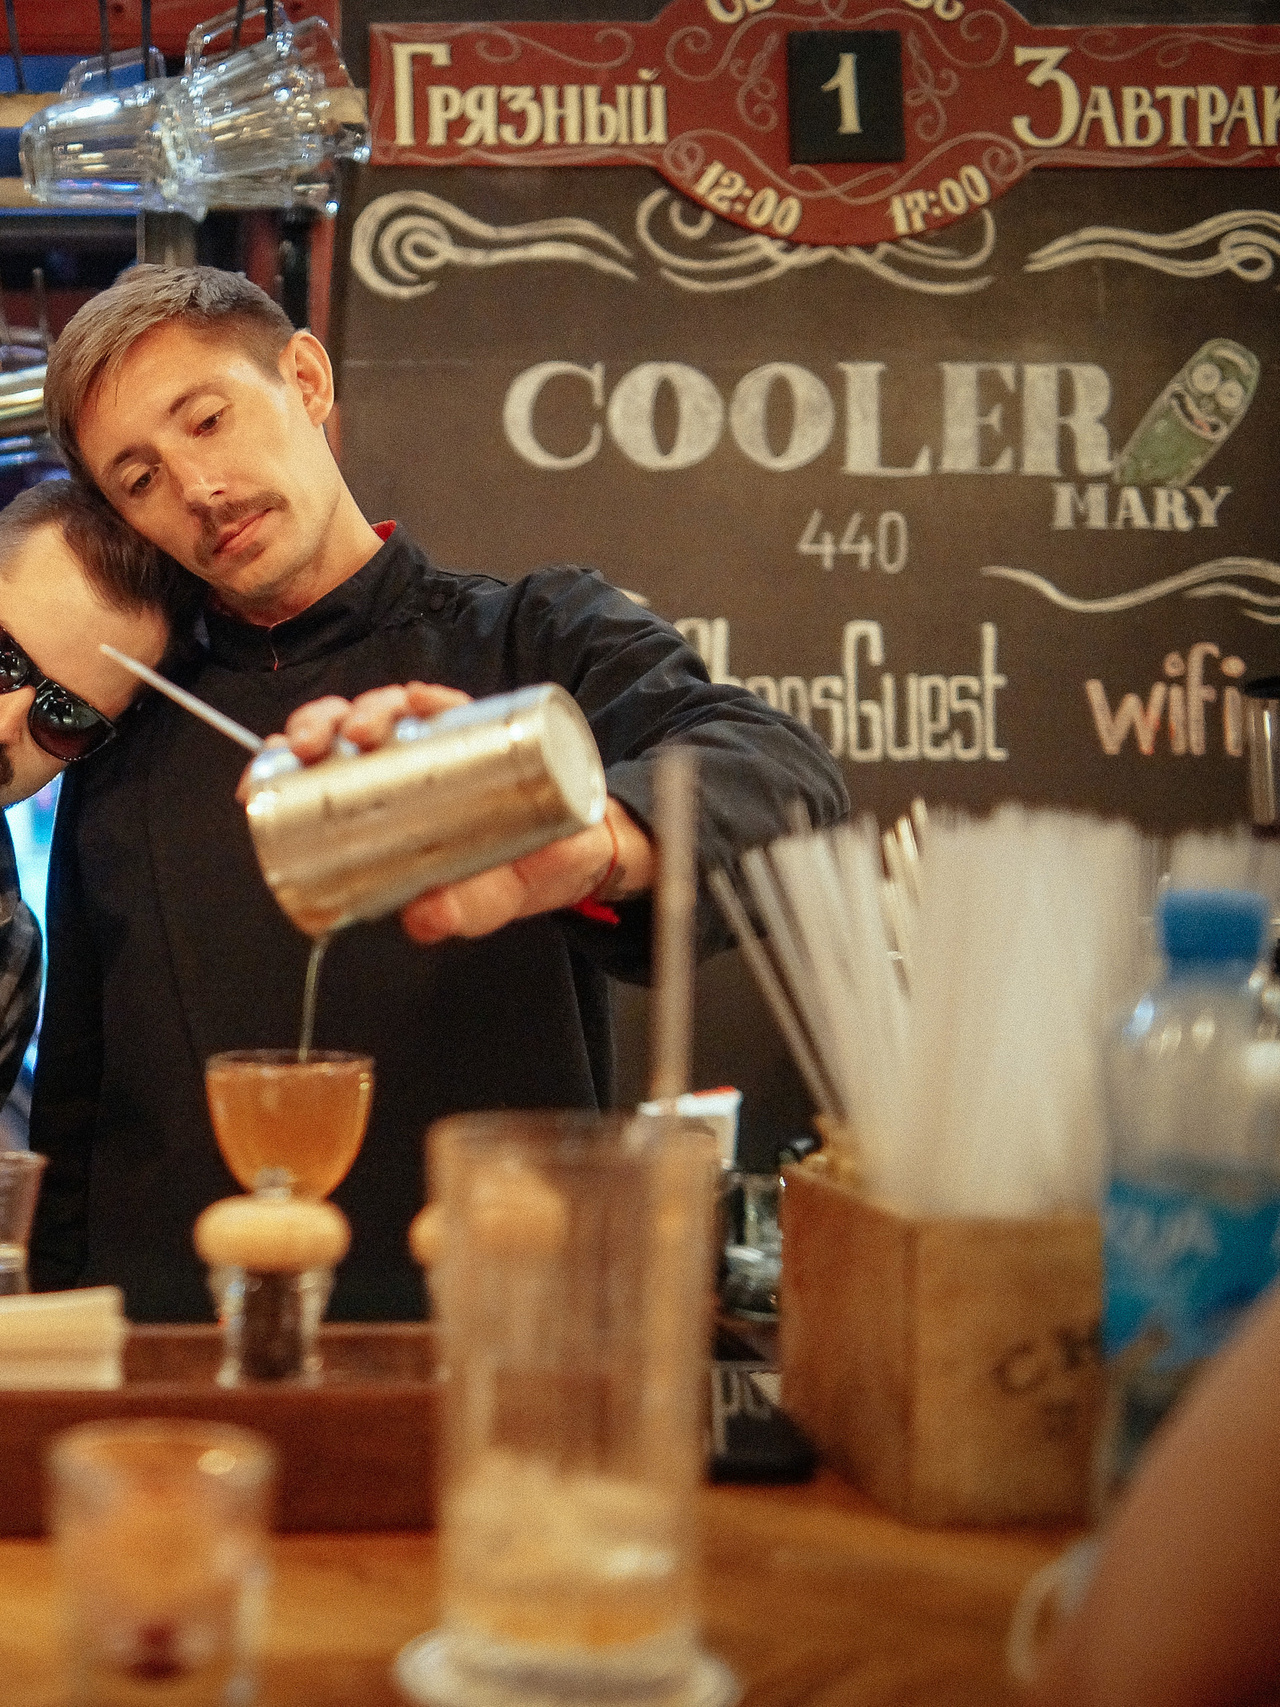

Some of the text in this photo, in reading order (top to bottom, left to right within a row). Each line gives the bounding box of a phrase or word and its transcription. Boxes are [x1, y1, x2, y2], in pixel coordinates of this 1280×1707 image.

[821, 52, 863, 134] 1
[694, 159, 802, 237] 12:00
[887, 165, 992, 235] 17:00
[502, 360, 1117, 476] COOLER
[796, 509, 909, 574] 440
[1051, 482, 1232, 532] MARY
[1085, 641, 1247, 757] wifi
